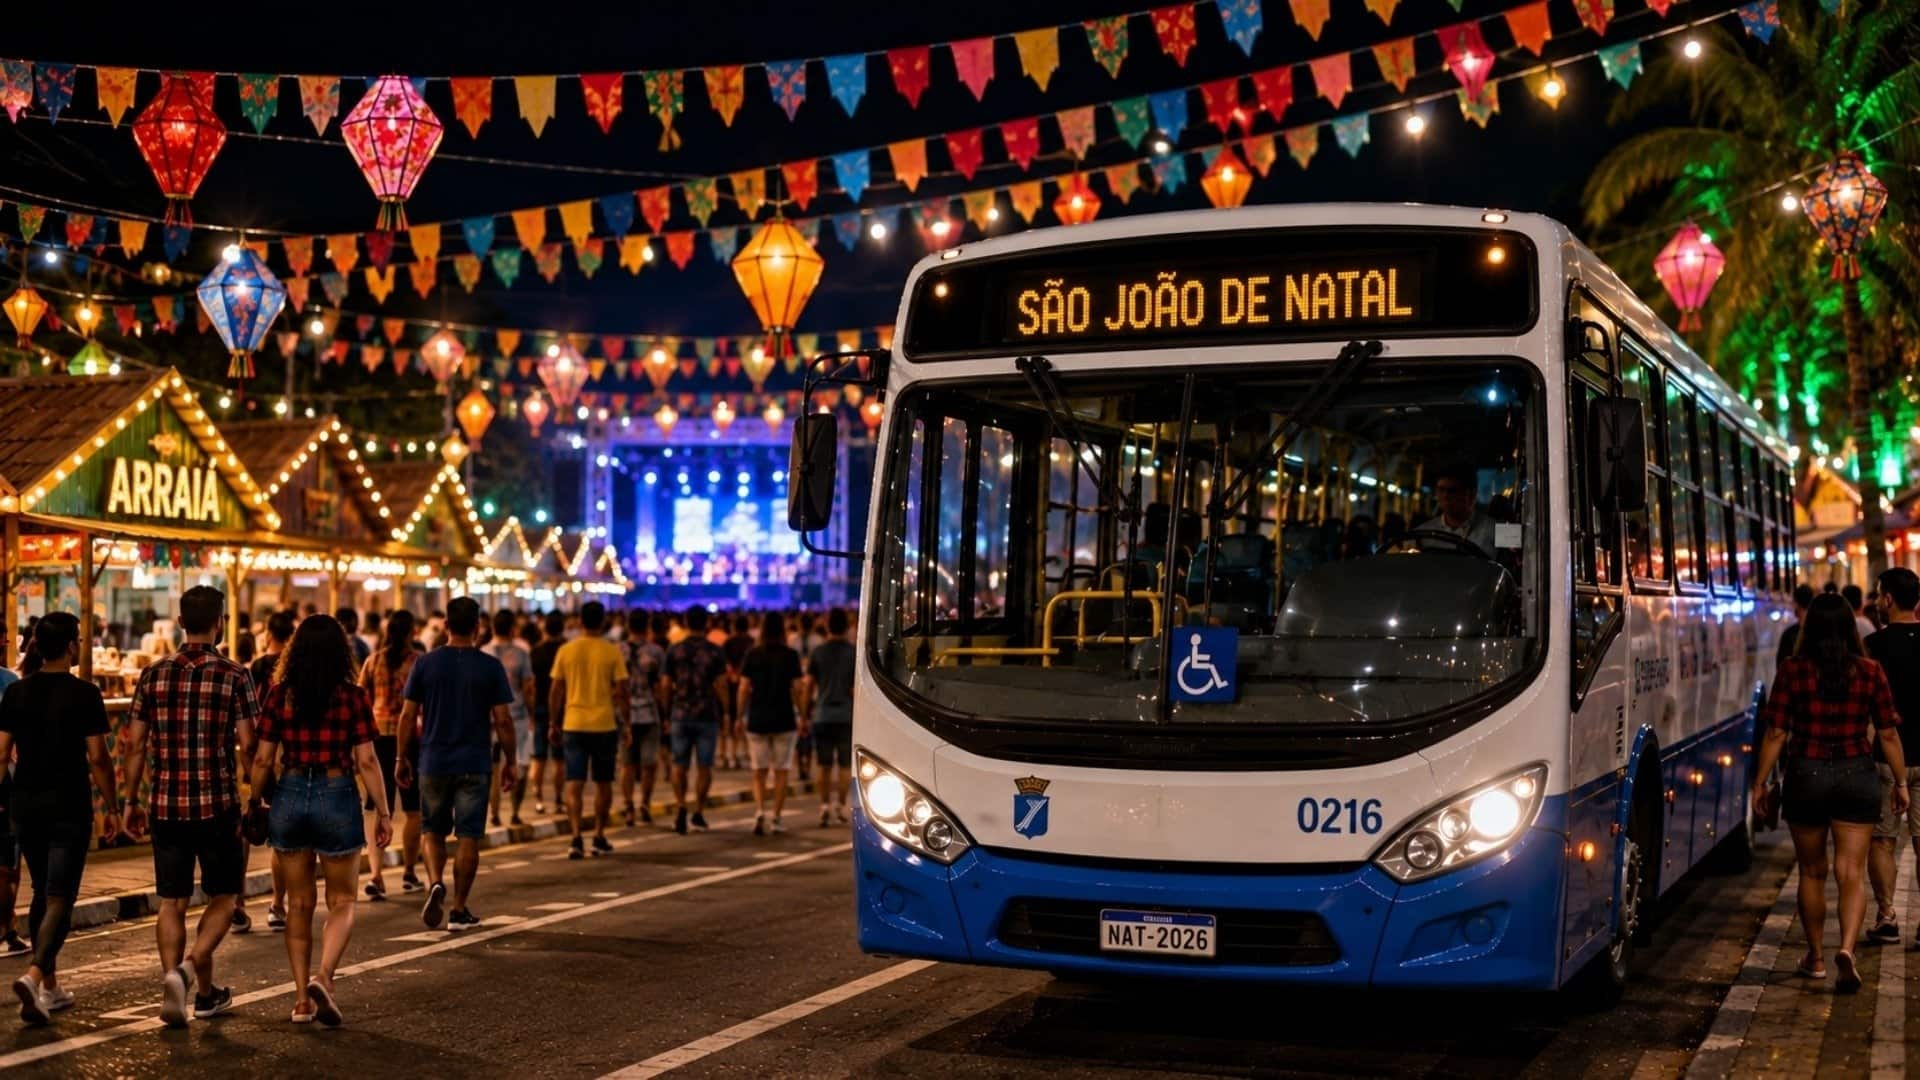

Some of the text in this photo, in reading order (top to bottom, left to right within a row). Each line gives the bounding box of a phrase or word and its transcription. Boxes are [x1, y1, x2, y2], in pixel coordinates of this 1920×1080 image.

[1018, 268, 1413, 335] SÃO JOÃO DE NATAL
[107, 456, 221, 523] ARRAIÁ
[1297, 797, 1383, 834] 0216
[1108, 924, 1208, 950] NAT-2026
